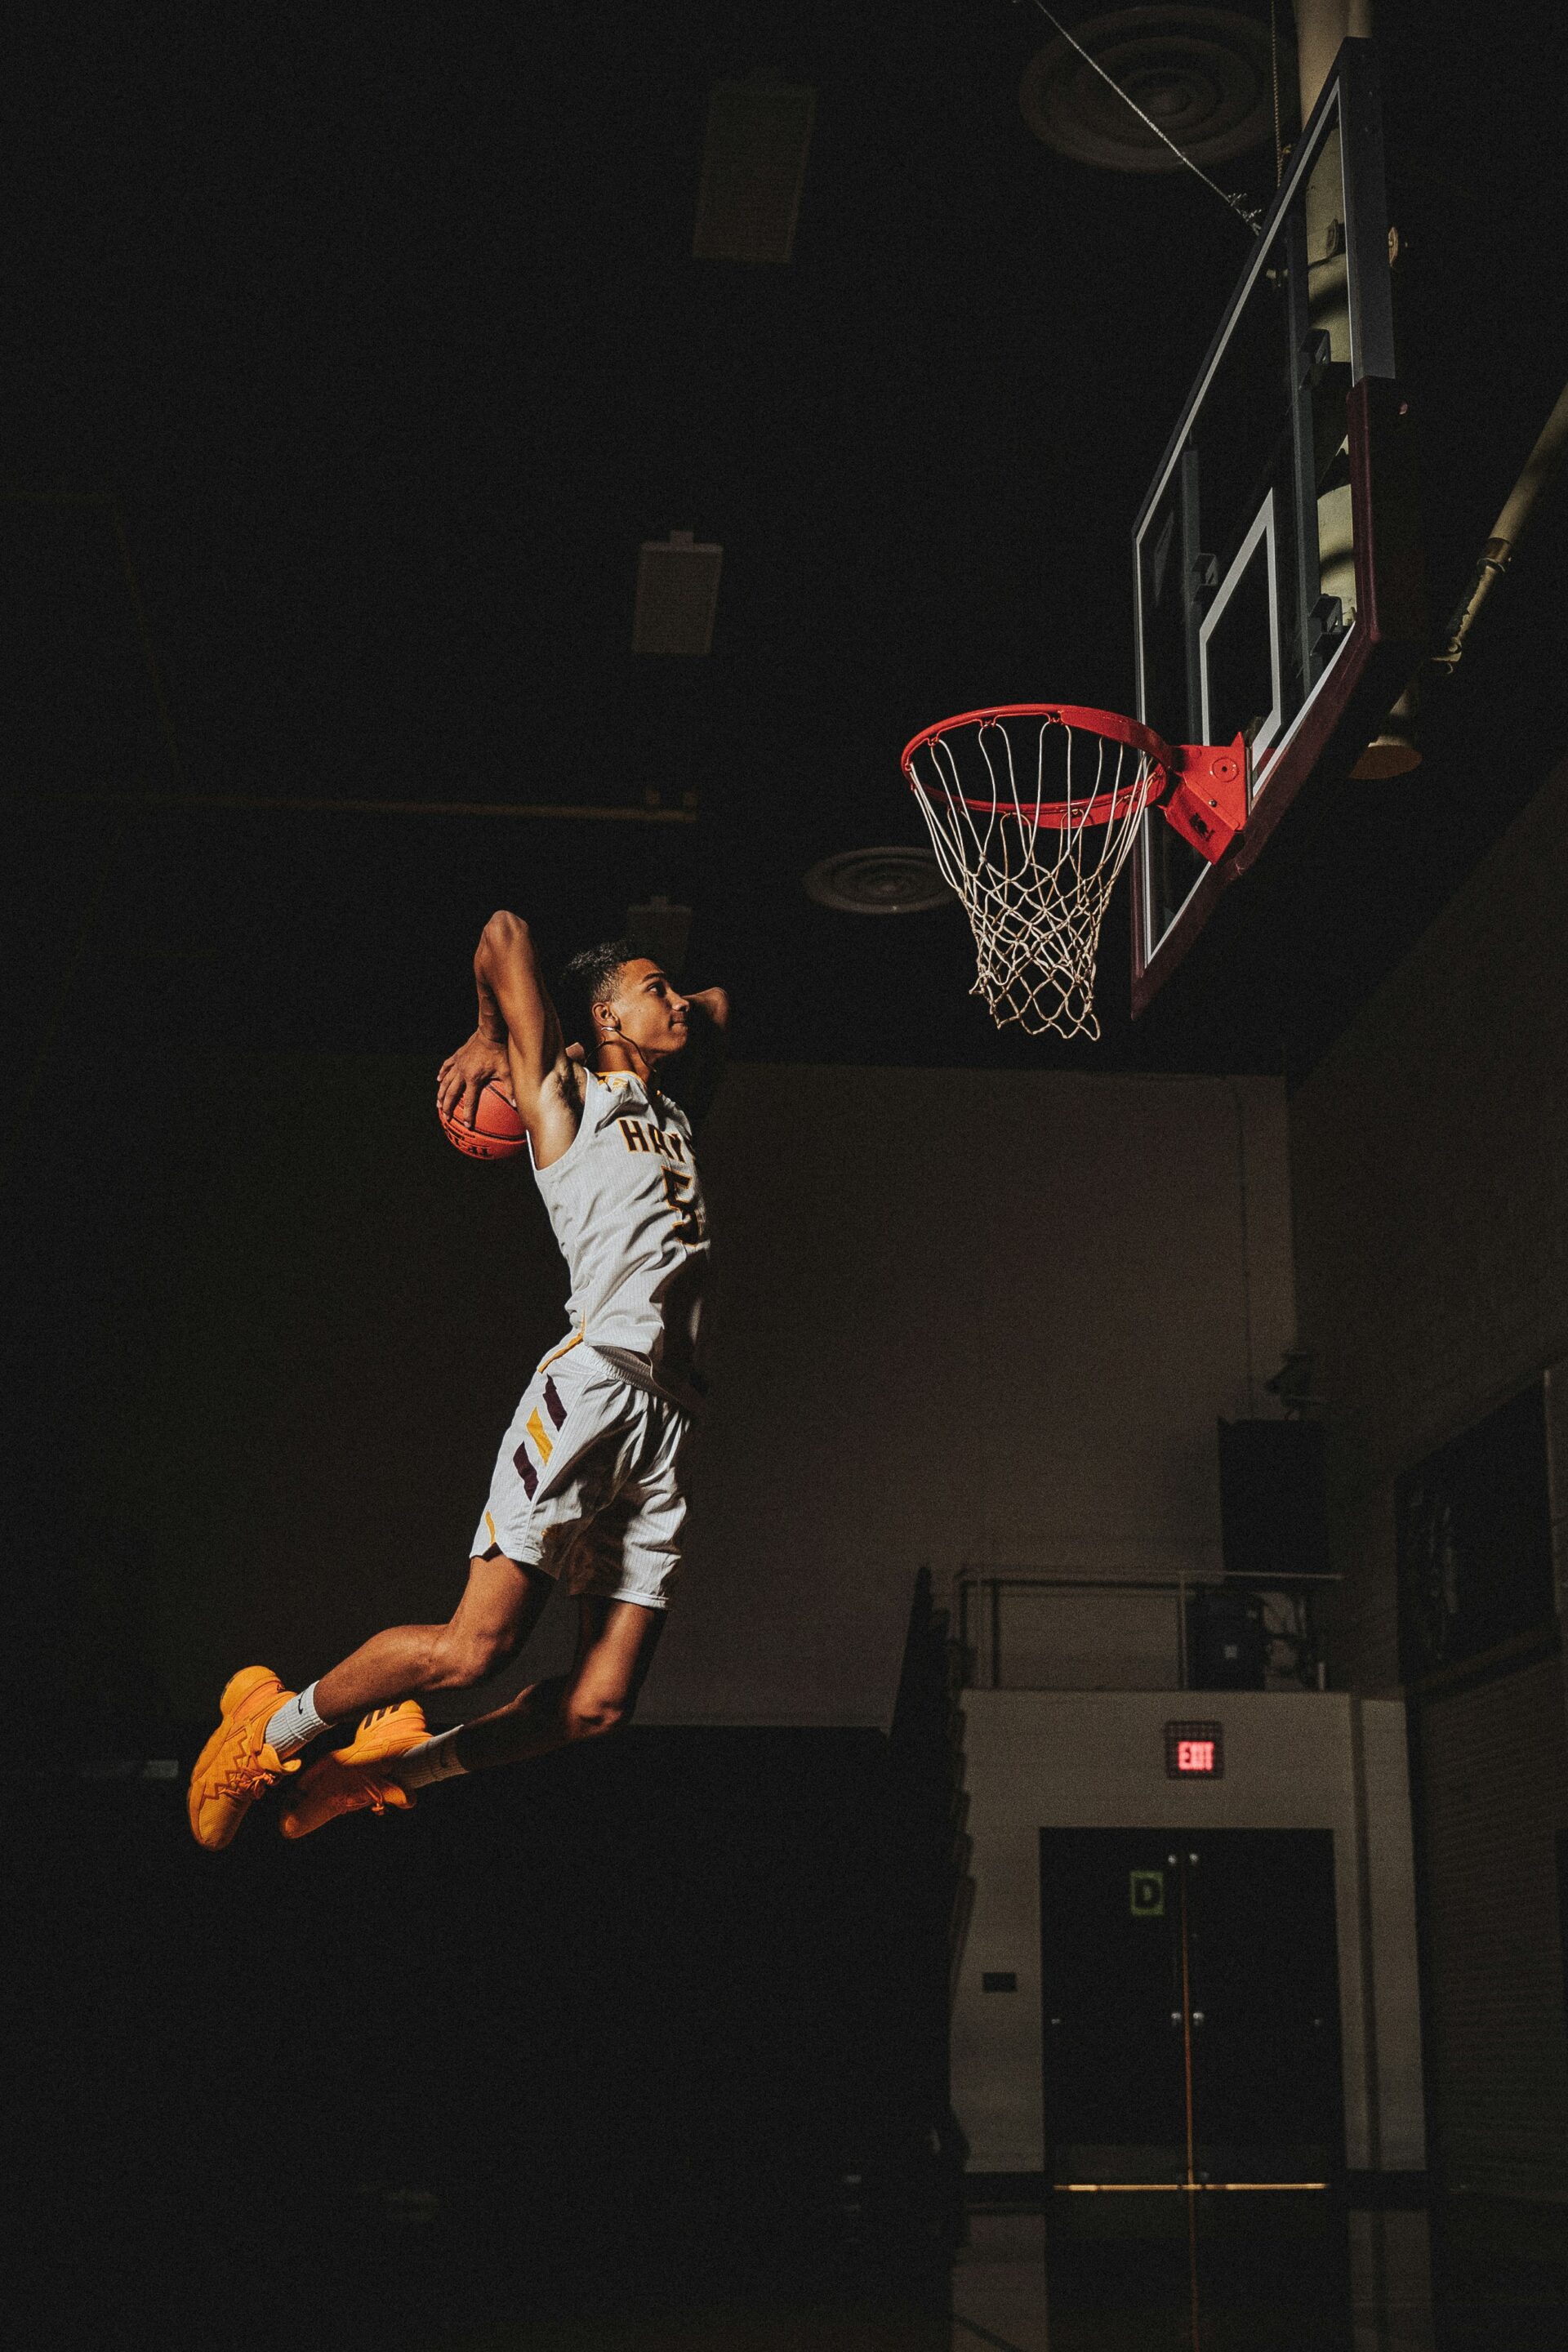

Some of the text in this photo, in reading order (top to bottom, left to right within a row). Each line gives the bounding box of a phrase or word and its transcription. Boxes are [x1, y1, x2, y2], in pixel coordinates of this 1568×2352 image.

[618, 1119, 697, 1165] HAY
[662, 1165, 700, 1247] 5
[1178, 1740, 1214, 1771] EXIT
[1135, 1879, 1160, 1909] D
